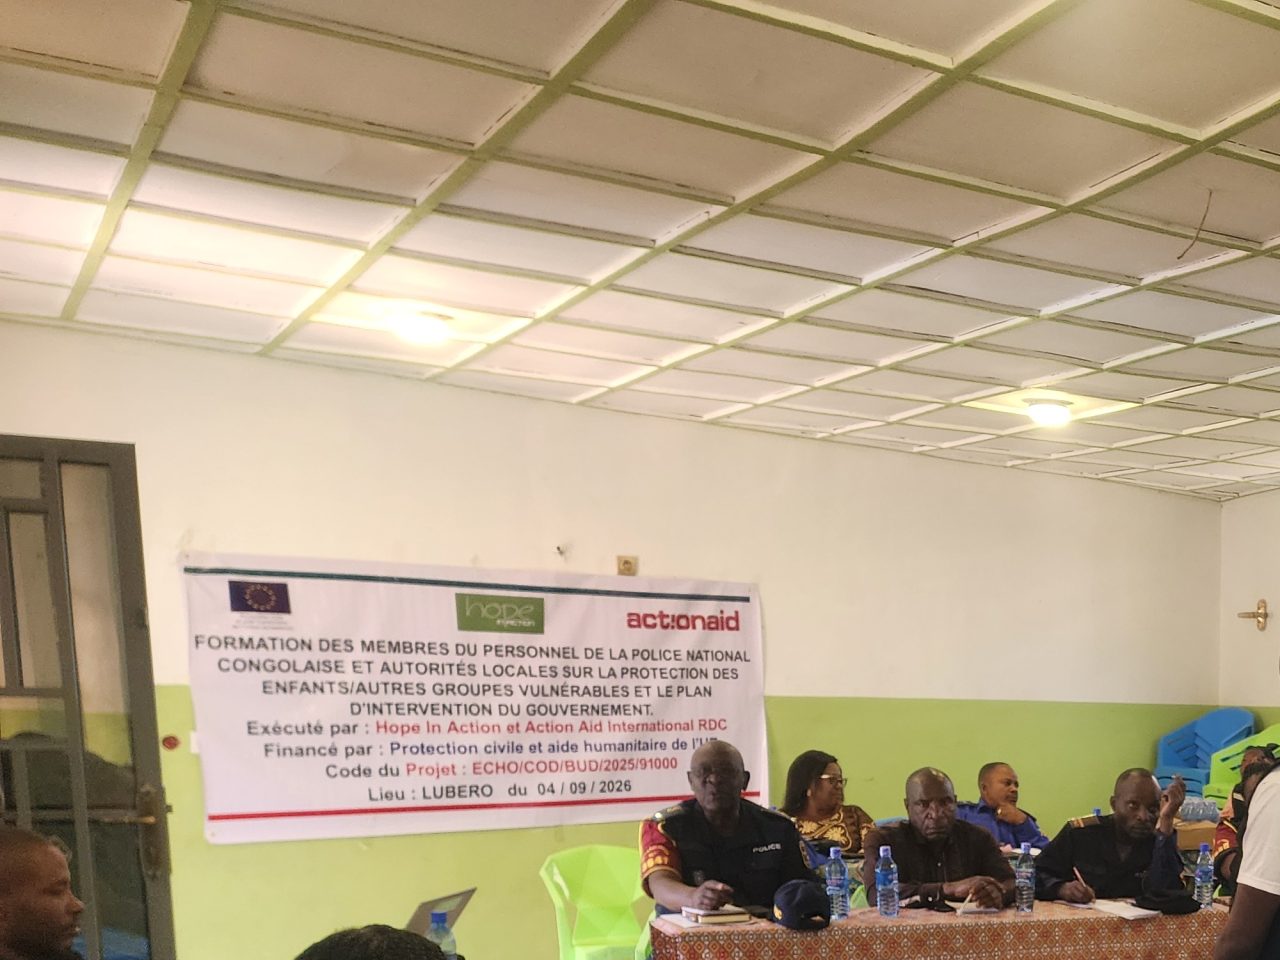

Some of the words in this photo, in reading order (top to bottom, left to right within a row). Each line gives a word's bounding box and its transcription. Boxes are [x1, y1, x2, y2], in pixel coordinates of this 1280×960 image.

[194, 635, 312, 652] FORMATION
[318, 638, 354, 653] DES
[360, 640, 449, 656] MEMBRES
[455, 643, 478, 657] DU
[483, 644, 580, 660] PERSONNEL
[584, 647, 605, 660] DE
[609, 648, 628, 661] LA
[631, 648, 683, 662] POLICE
[686, 649, 751, 663] NATIONAL
[217, 657, 346, 674] CONGOLAISE
[351, 660, 374, 674] ET
[380, 659, 478, 677] AUTORITÉS
[482, 664, 558, 679] LOCALES
[562, 665, 594, 679] SUR
[598, 665, 617, 679] LA
[620, 666, 709, 680] PROTECTION
[712, 667, 739, 680] DES
[262, 680, 426, 696] ENFANTS/AUTRES
[432, 682, 514, 697] GROUPES
[518, 681, 630, 698] VULNÉRABLES
[634, 685, 652, 698] ET
[657, 685, 673, 698] LE
[676, 685, 712, 698] PLAN
[350, 702, 493, 717] D'INTERVENTION
[498, 703, 521, 717] DU
[525, 703, 654, 717] GOUVERNEMENT.
[246, 720, 324, 736] Exécuté
[330, 723, 359, 740] par
[375, 720, 421, 738] Hope
[426, 720, 441, 734] In
[449, 720, 501, 735] Action
[506, 721, 521, 734] et
[524, 720, 573, 734] Action
[578, 719, 603, 733] Aid
[607, 718, 694, 733] International
[698, 718, 728, 732] RDC
[263, 741, 338, 758] Financé
[344, 744, 373, 761] par
[389, 739, 479, 756] Protection
[483, 740, 523, 755] civile
[528, 740, 543, 754] et
[546, 740, 579, 754] aide
[583, 738, 668, 753] humanitaire
[671, 738, 688, 751] de
[325, 764, 372, 779] Code
[378, 763, 400, 778] du
[405, 761, 457, 781] Projet
[472, 756, 678, 775] ECHO/COD/BUD/2025/91000
[368, 787, 405, 802] Lieu
[422, 783, 494, 800] LUBERO
[508, 782, 528, 797] du
[537, 782, 556, 796] 04
[569, 781, 587, 795] 09
[598, 780, 632, 794] 2026
